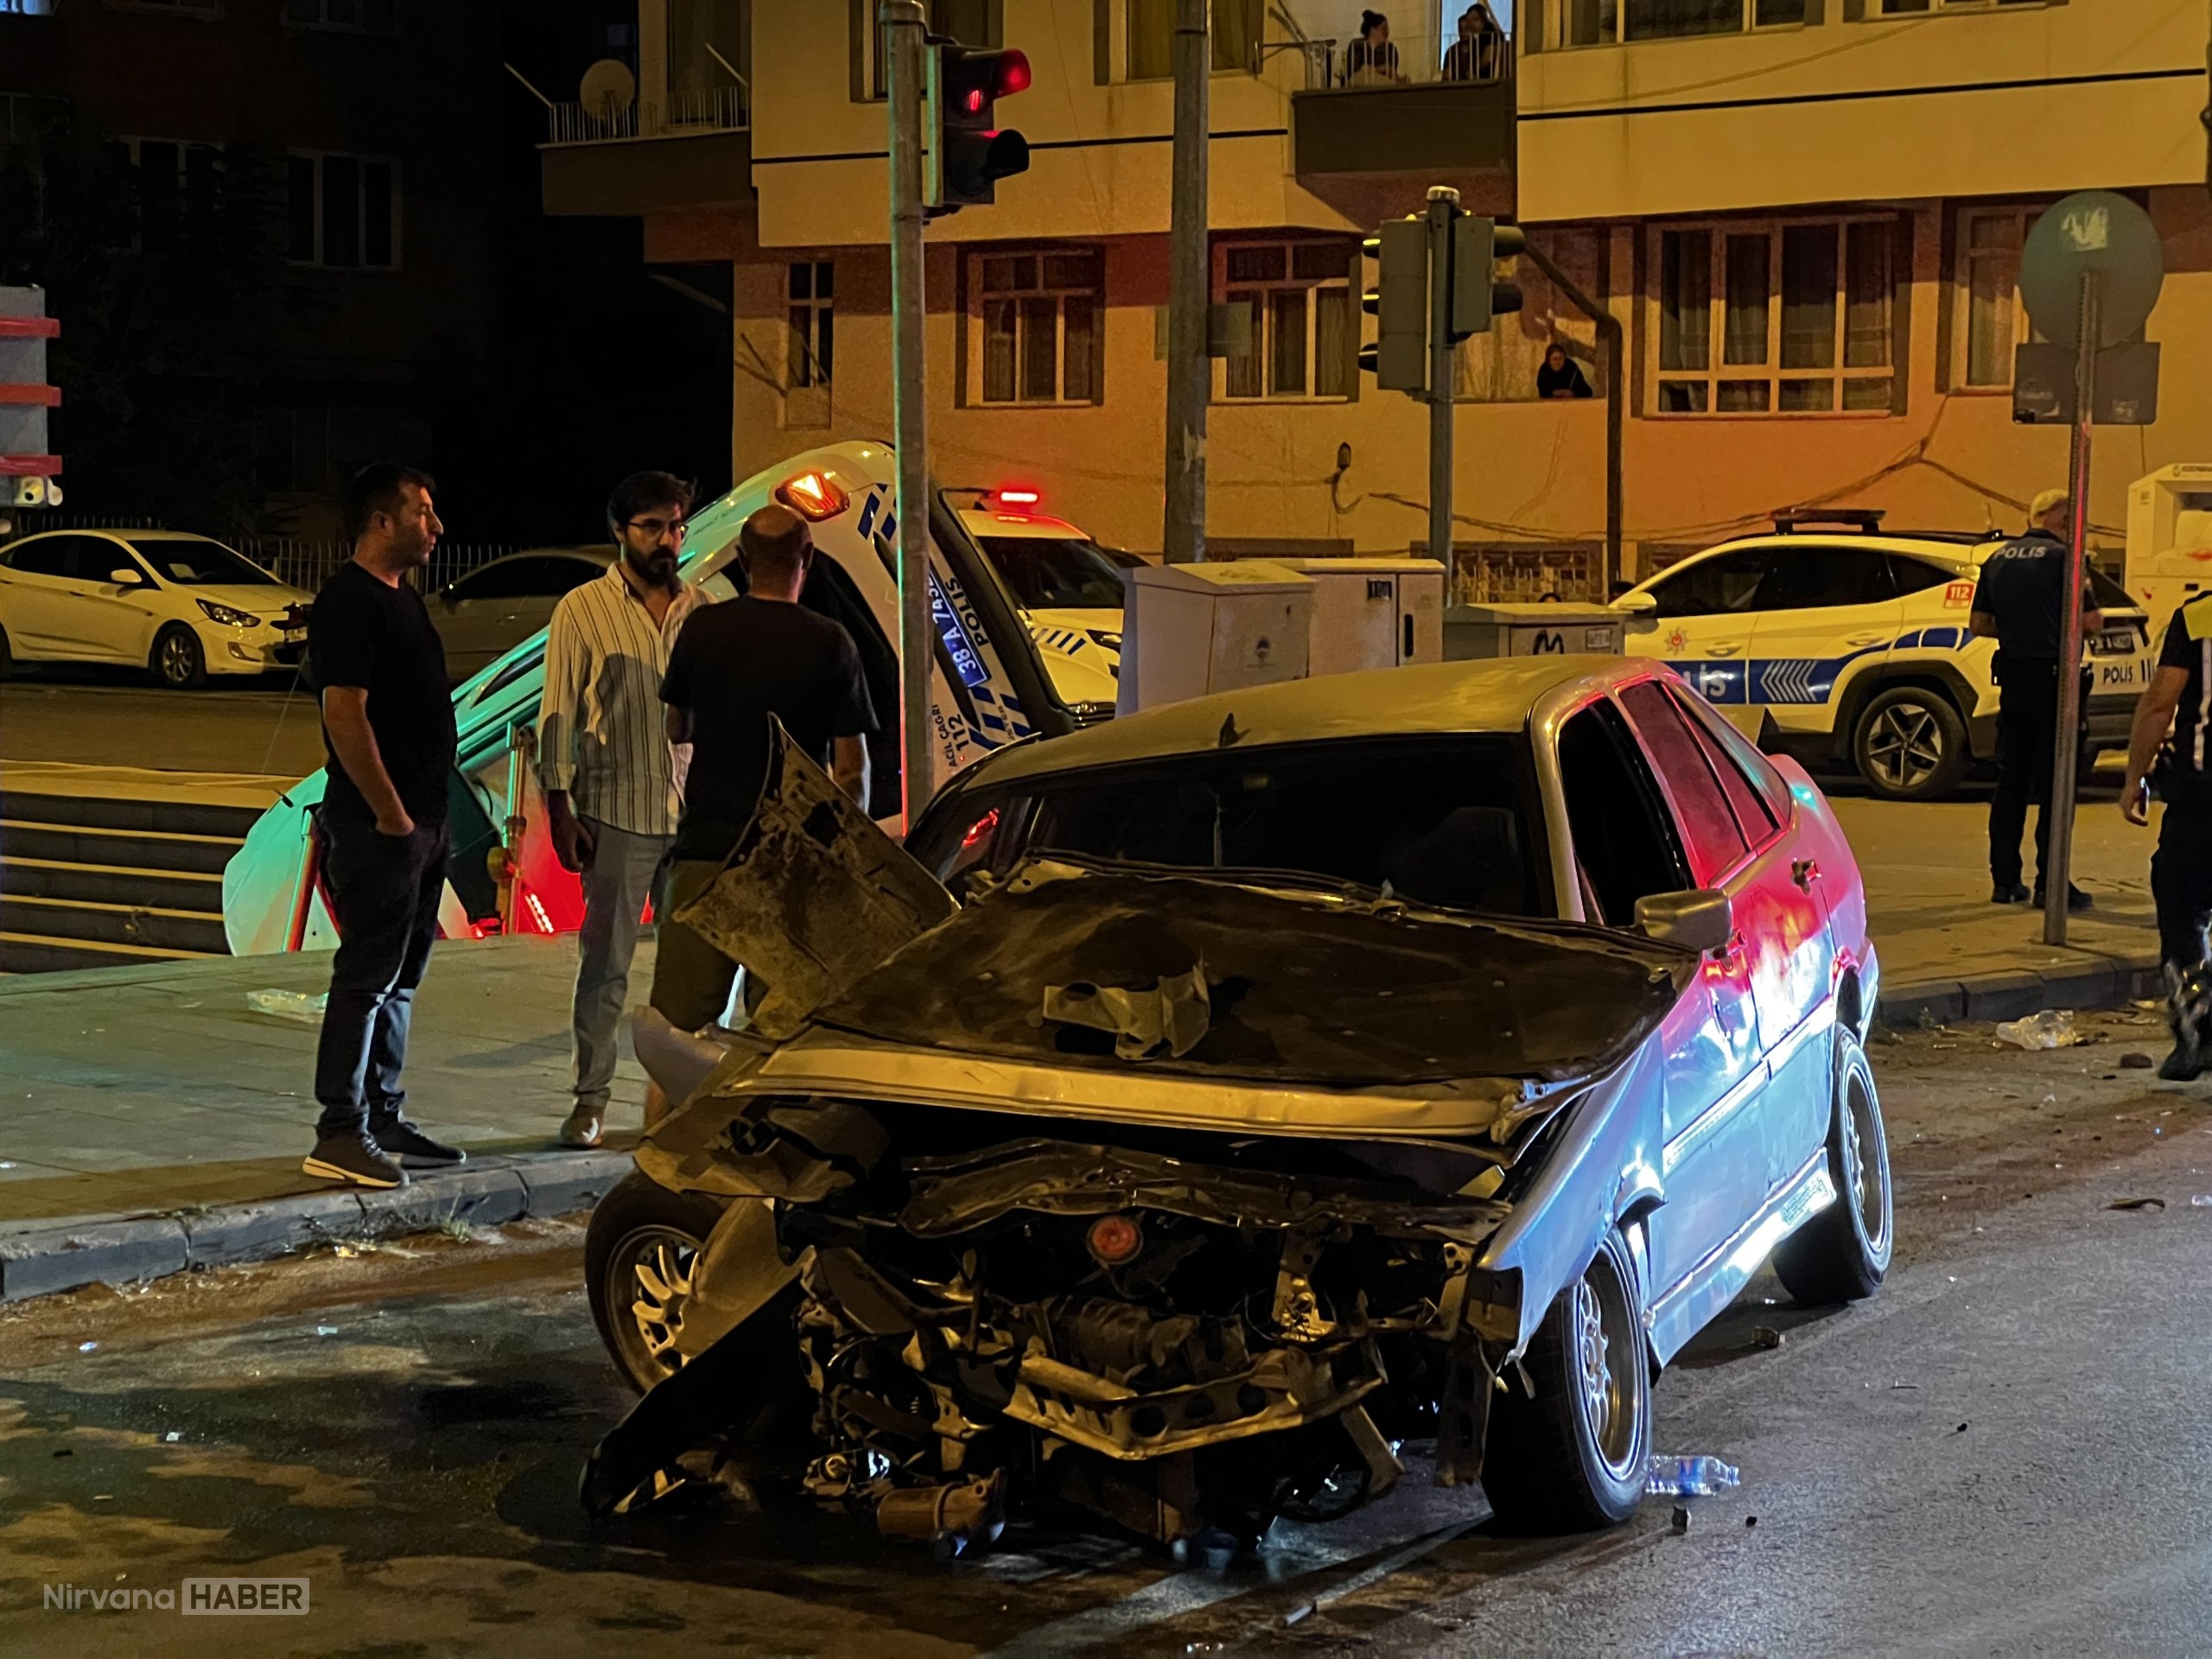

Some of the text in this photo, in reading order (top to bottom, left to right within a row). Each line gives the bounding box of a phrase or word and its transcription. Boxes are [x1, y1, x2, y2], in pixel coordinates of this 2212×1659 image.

[1949, 585, 1971, 599] 112
[942, 626, 962, 640] A
[952, 648, 977, 674] 38
[948, 713, 969, 752] 112
